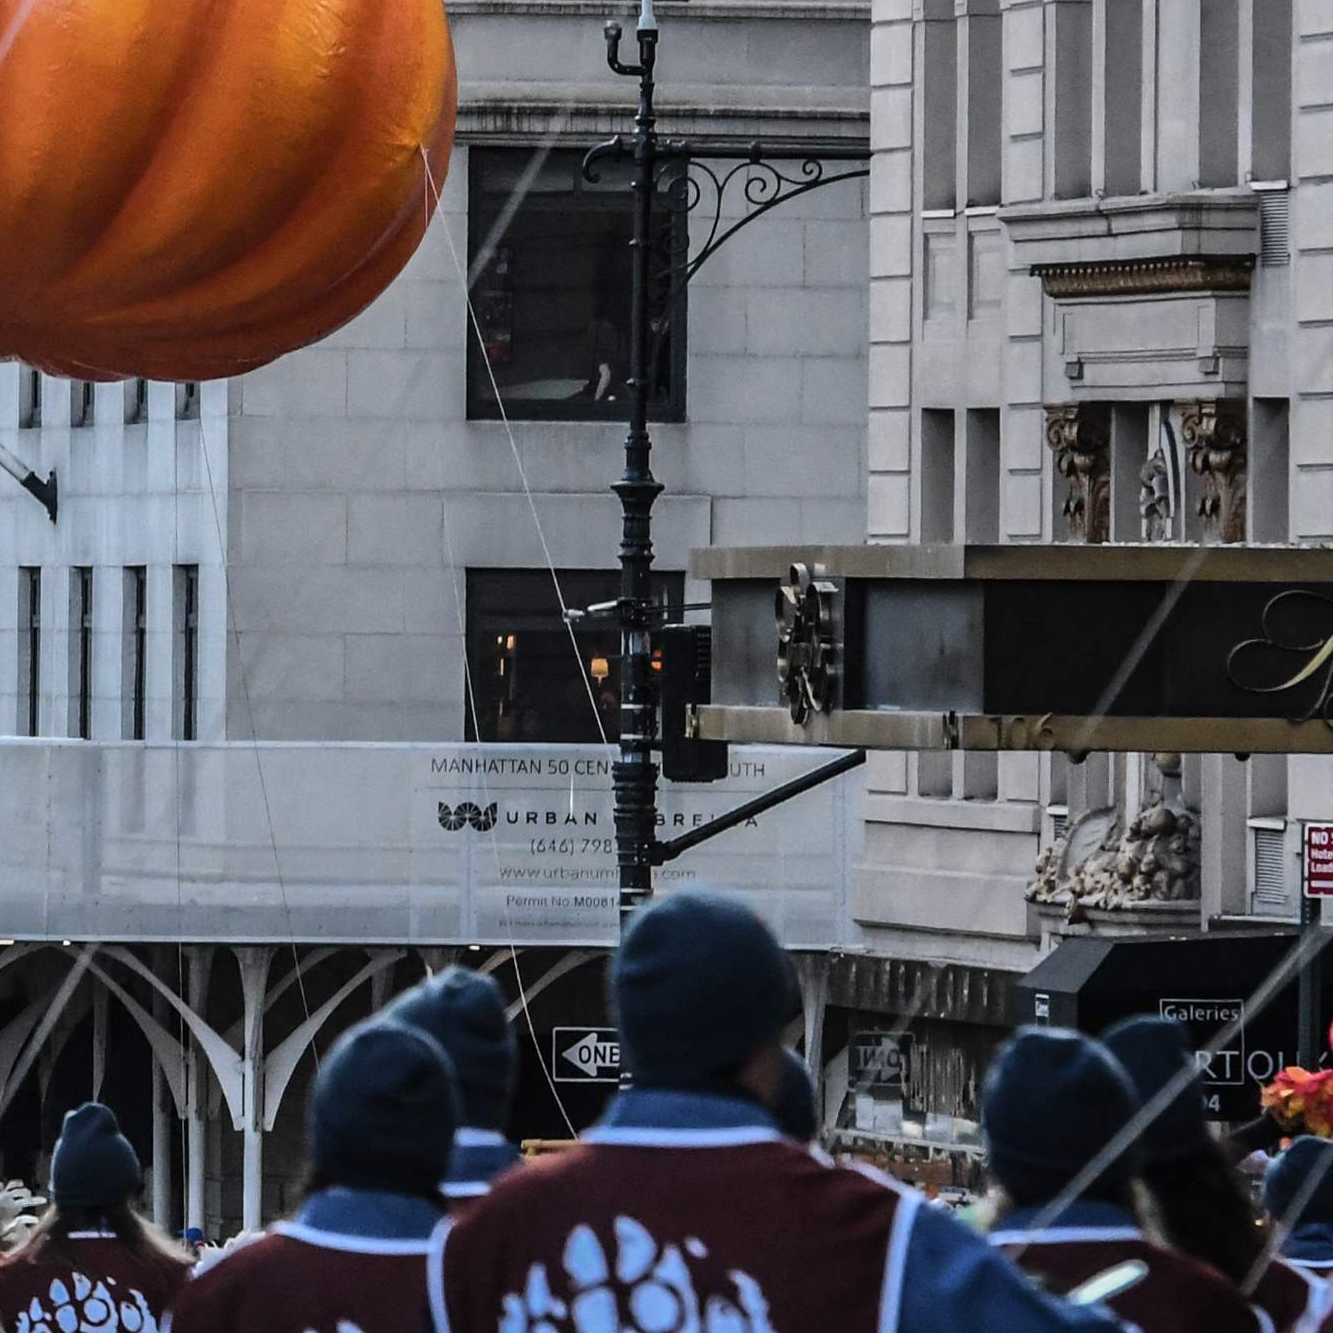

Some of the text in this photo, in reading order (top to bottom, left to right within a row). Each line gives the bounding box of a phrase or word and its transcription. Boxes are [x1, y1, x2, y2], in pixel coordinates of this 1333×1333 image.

[431, 757, 765, 778] MANHATTAN 50 CEN UTH
[506, 810, 597, 826] URBAN
[530, 838, 614, 856] (646) 798
[1311, 831, 1329, 846] NO
[1311, 848, 1333, 860] Hote
[506, 895, 548, 908] Permit
[1164, 1004, 1239, 1022] Galeries
[578, 1044, 620, 1064] ONE
